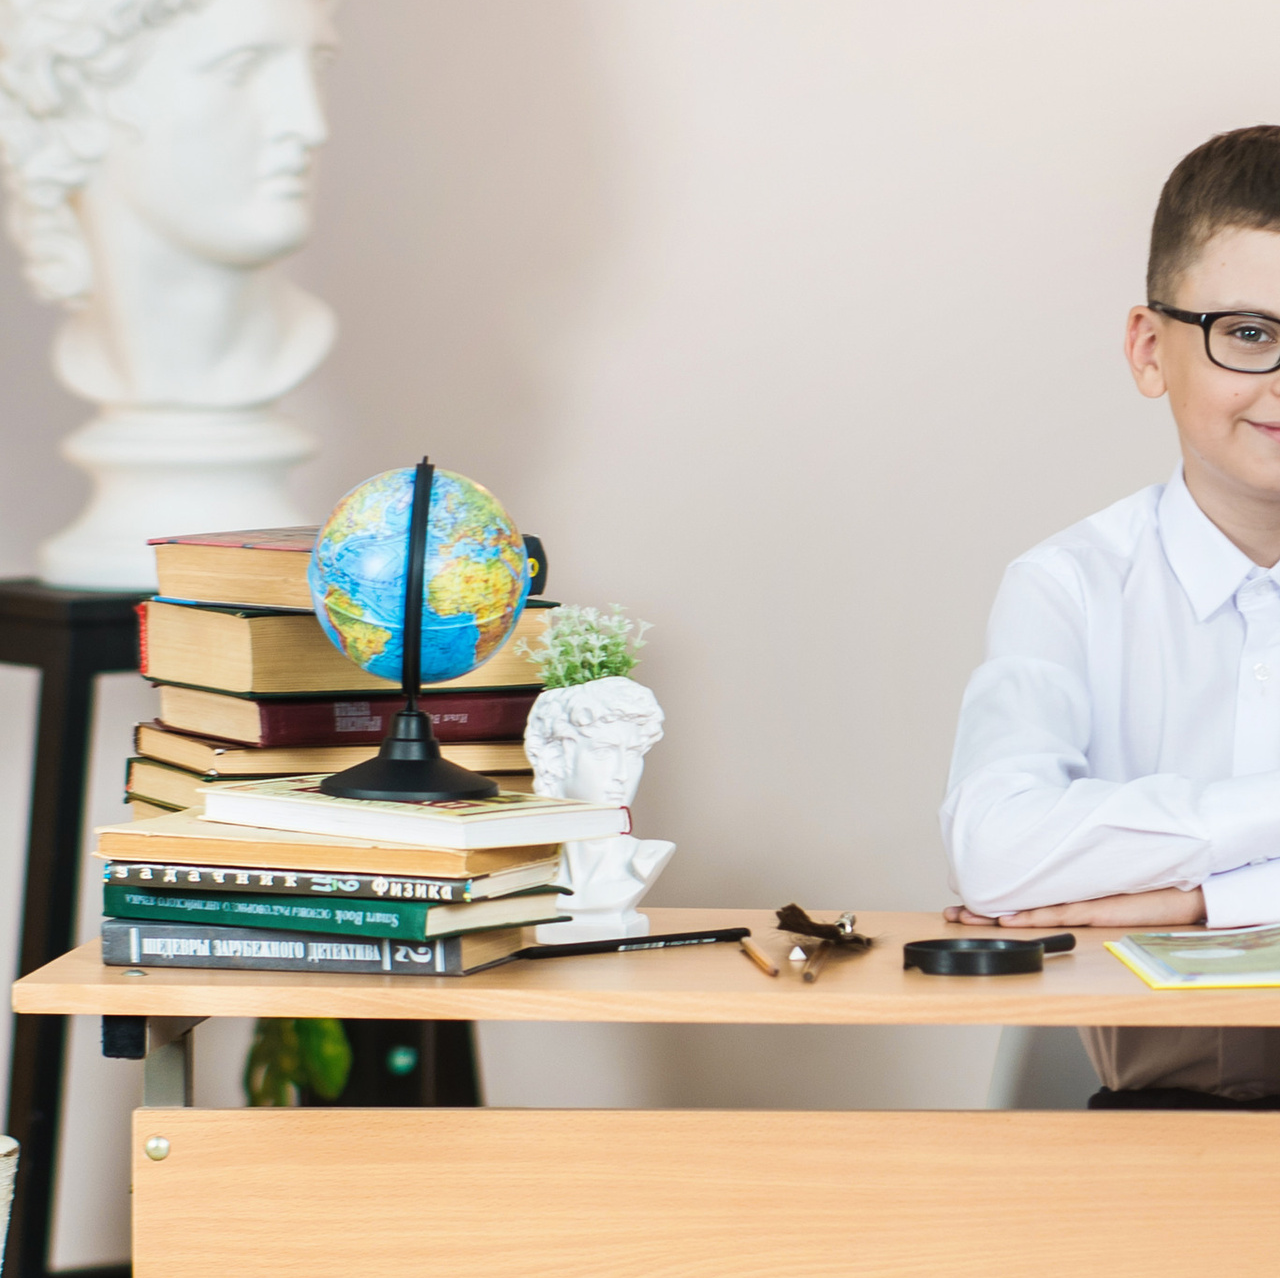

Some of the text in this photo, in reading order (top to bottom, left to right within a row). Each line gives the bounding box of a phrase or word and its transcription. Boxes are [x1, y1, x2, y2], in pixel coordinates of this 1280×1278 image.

[371, 876, 453, 900] Физика
[335, 909, 399, 928] Smart Book
[142, 938, 211, 959] ШЕДЕВРЫ
[213, 939, 305, 960] ЗАРУБЕЖНОГО
[307, 941, 381, 963] ДЕТЕКТИВА
